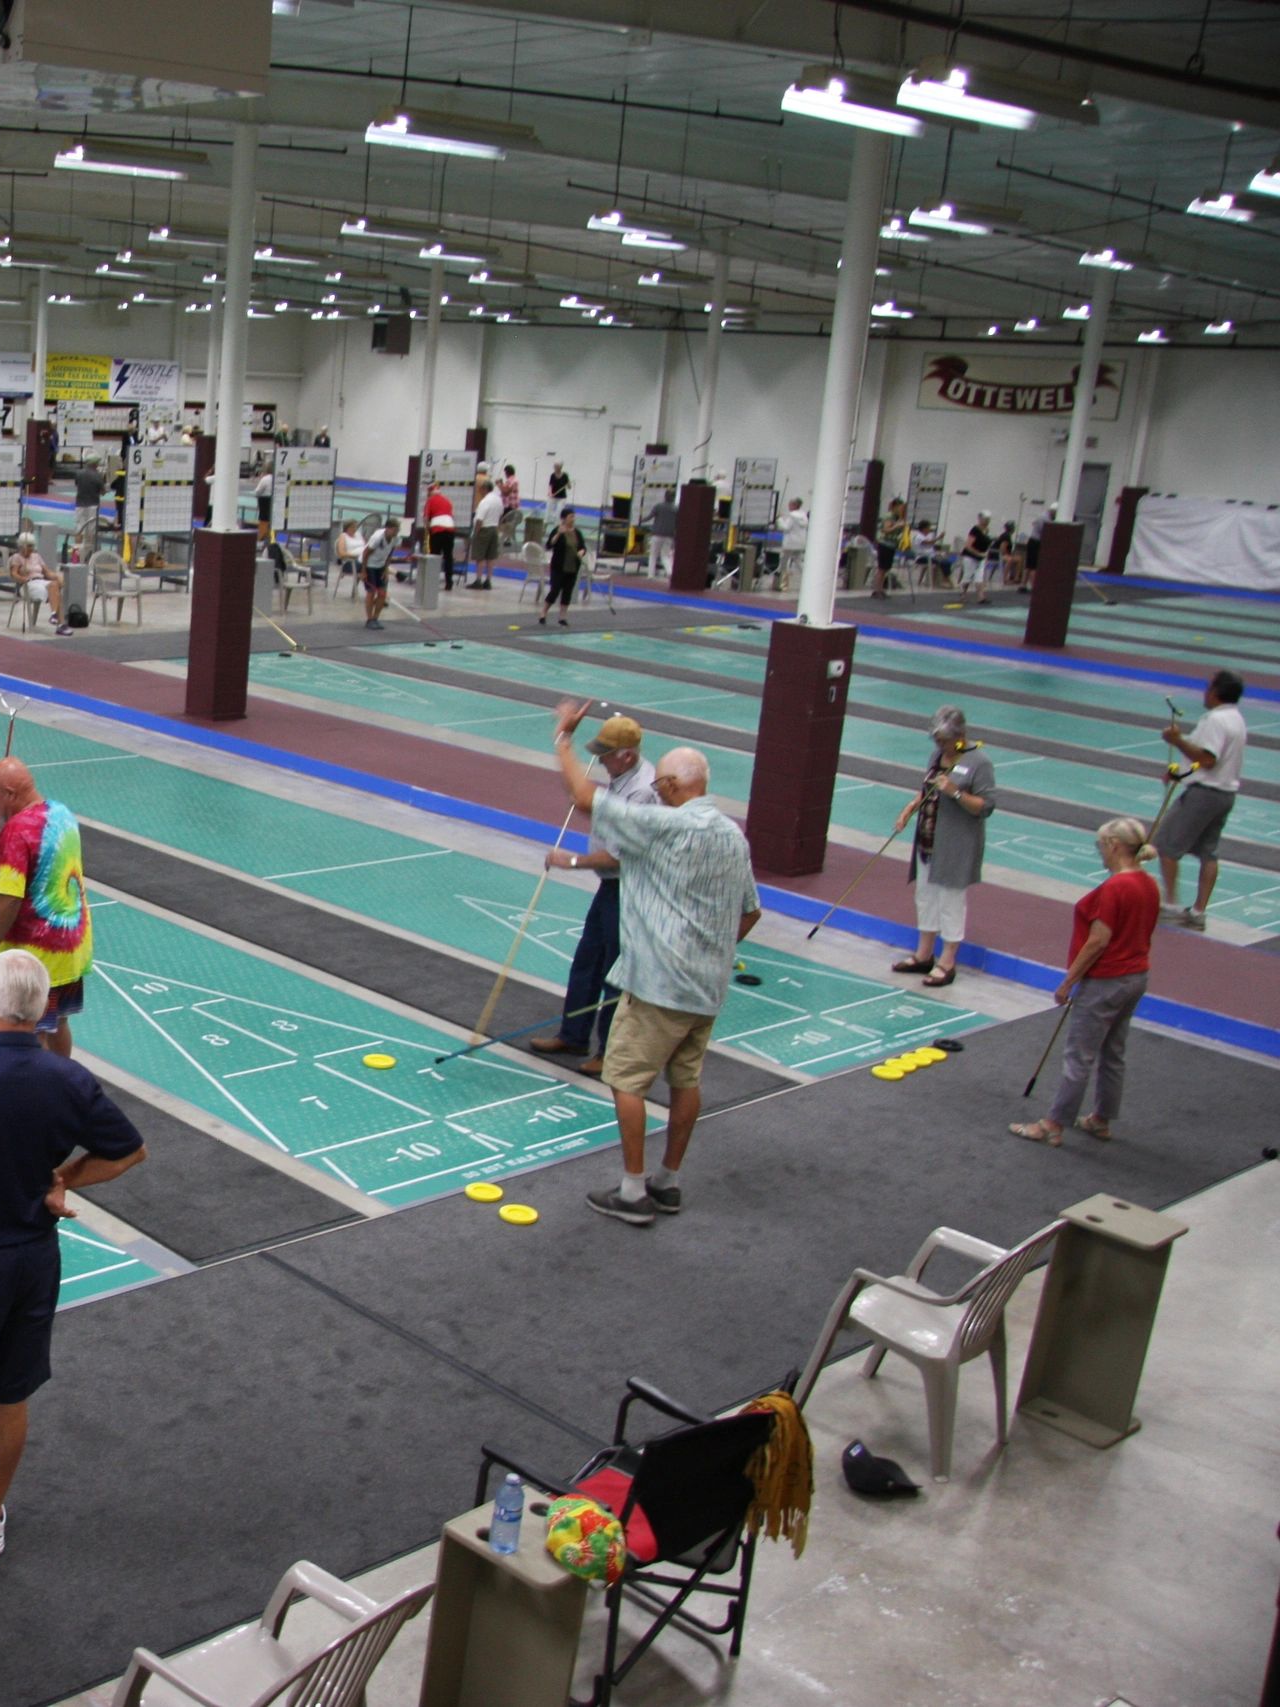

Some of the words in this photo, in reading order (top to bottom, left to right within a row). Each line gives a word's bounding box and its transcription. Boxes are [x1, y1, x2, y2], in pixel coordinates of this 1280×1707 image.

[130, 363, 177, 377] THISTLE
[947, 378, 1079, 411] OTTEWEL
[263, 411, 274, 432] 9
[133, 450, 141, 465] 6
[280, 451, 288, 465] 7
[425, 452, 432, 467] 8
[639, 460, 645, 470] 9
[737, 461, 748, 473] 10
[912, 465, 921, 476] 12
[132, 981, 169, 996] 10
[886, 1005, 925, 1020] -10
[270, 1019, 299, 1032] 8
[201, 1033, 230, 1047] 8
[790, 1030, 832, 1046] -10
[417, 1068, 445, 1081] 7
[299, 1095, 329, 1111] 7
[527, 1104, 579, 1124] -10
[385, 1141, 442, 1165] -10
[504, 1154, 538, 1167] WALK
[554, 1137, 590, 1151] COURT
